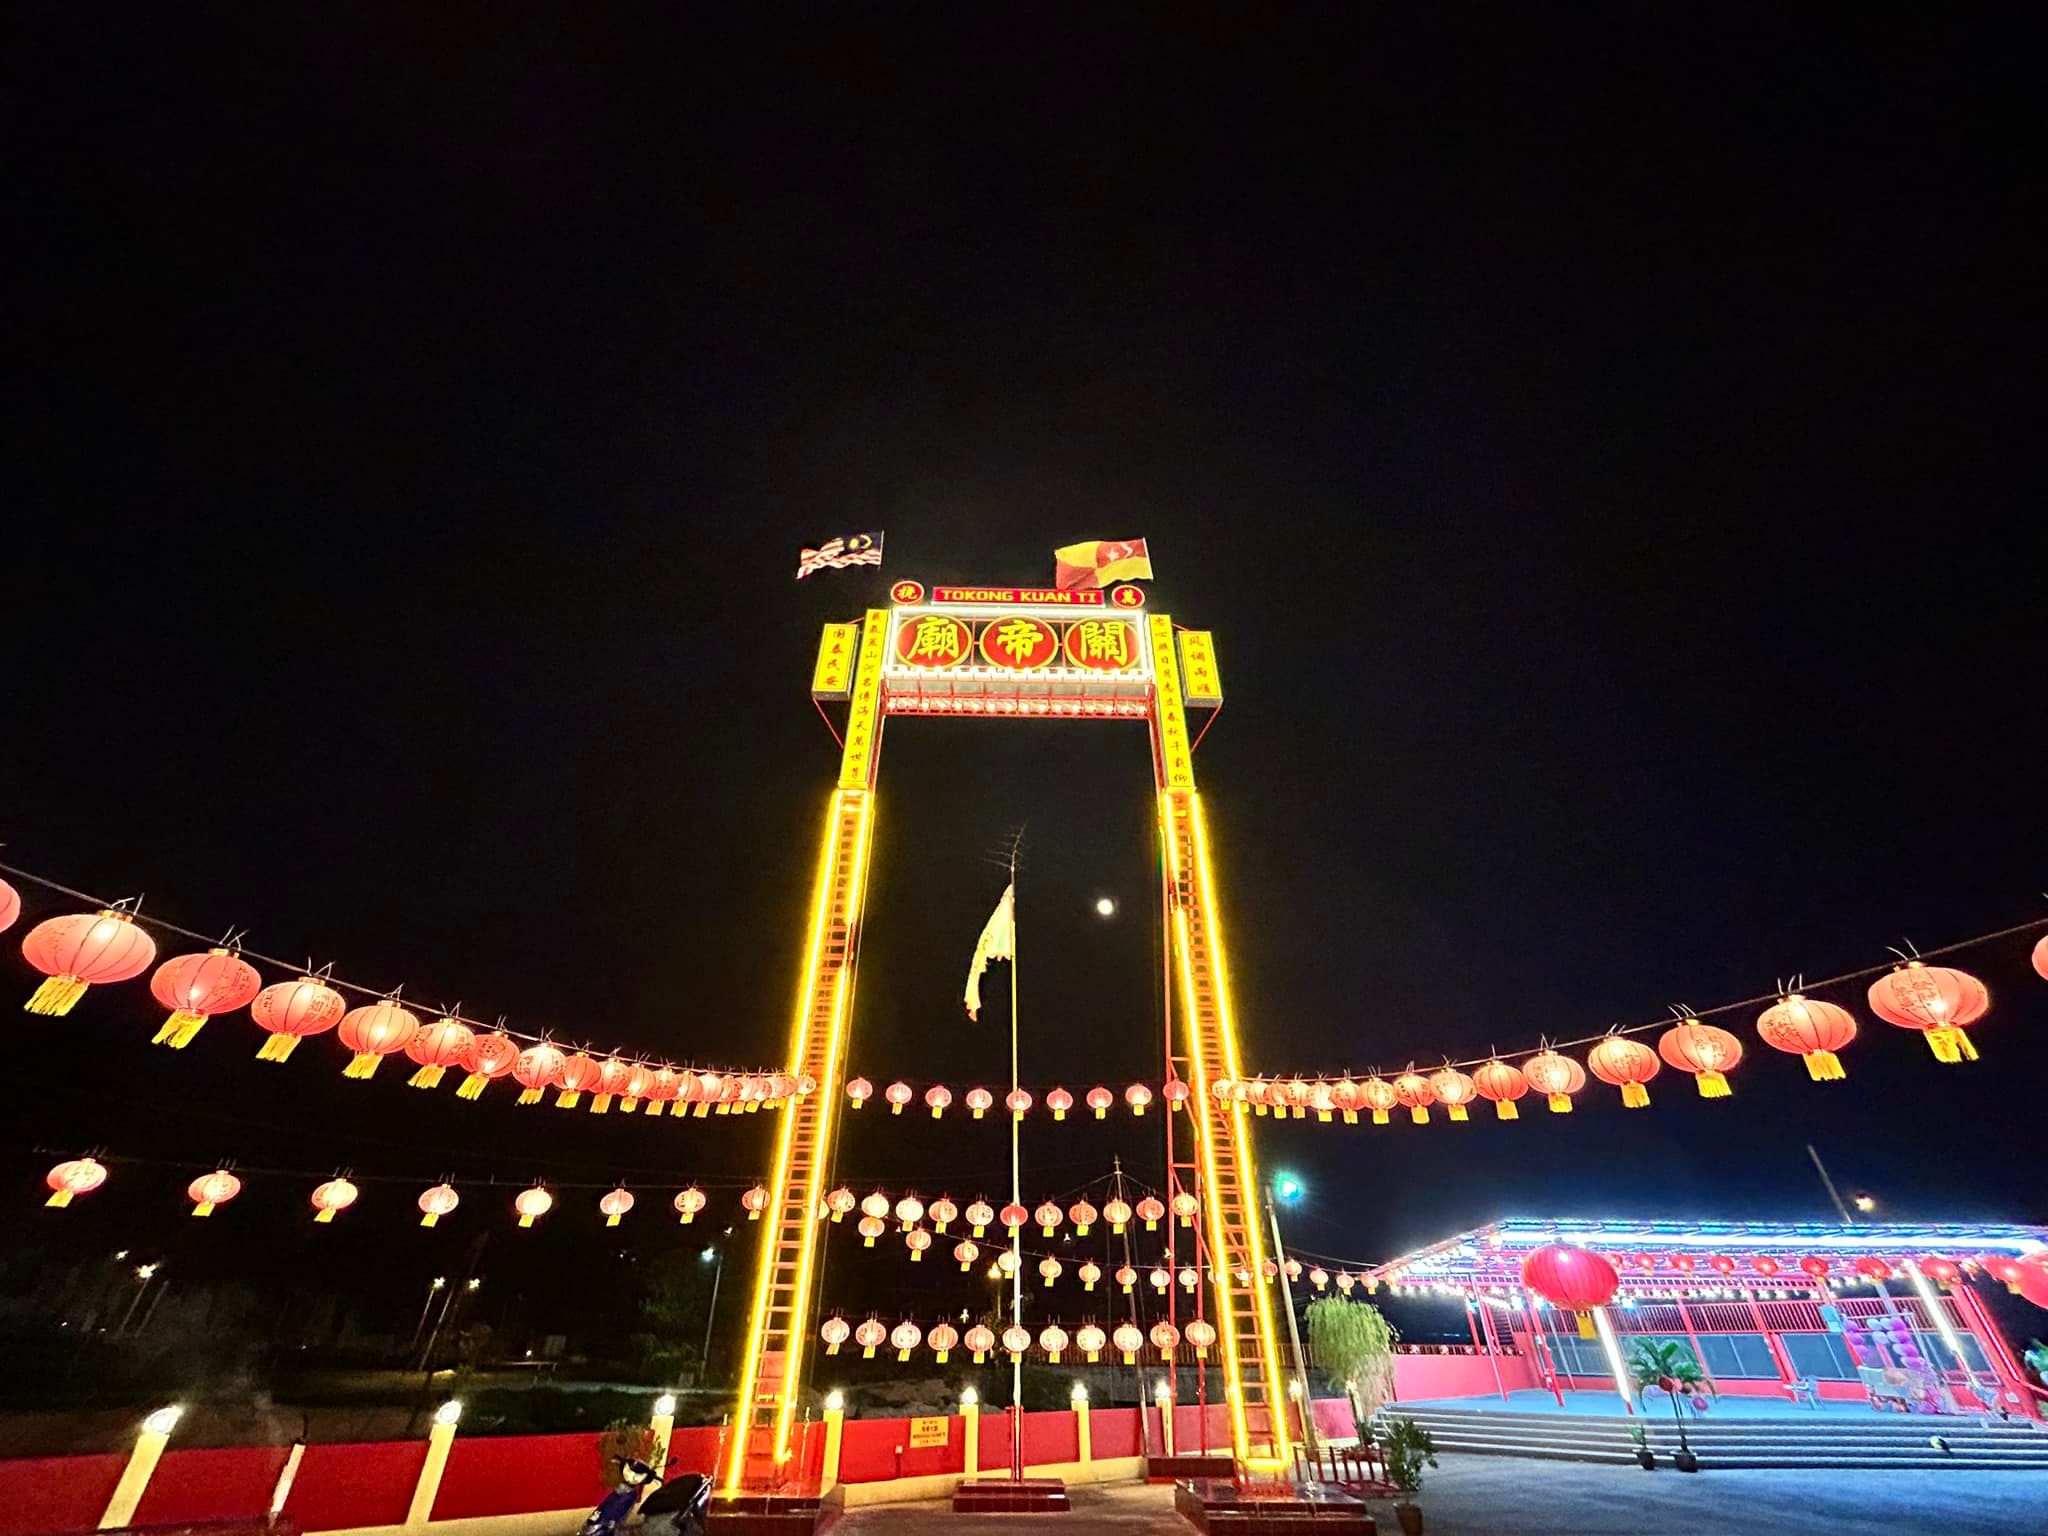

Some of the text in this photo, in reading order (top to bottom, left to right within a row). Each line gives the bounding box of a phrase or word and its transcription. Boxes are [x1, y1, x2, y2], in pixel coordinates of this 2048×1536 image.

[941, 589, 1097, 604] TOKONG KUAN TI
